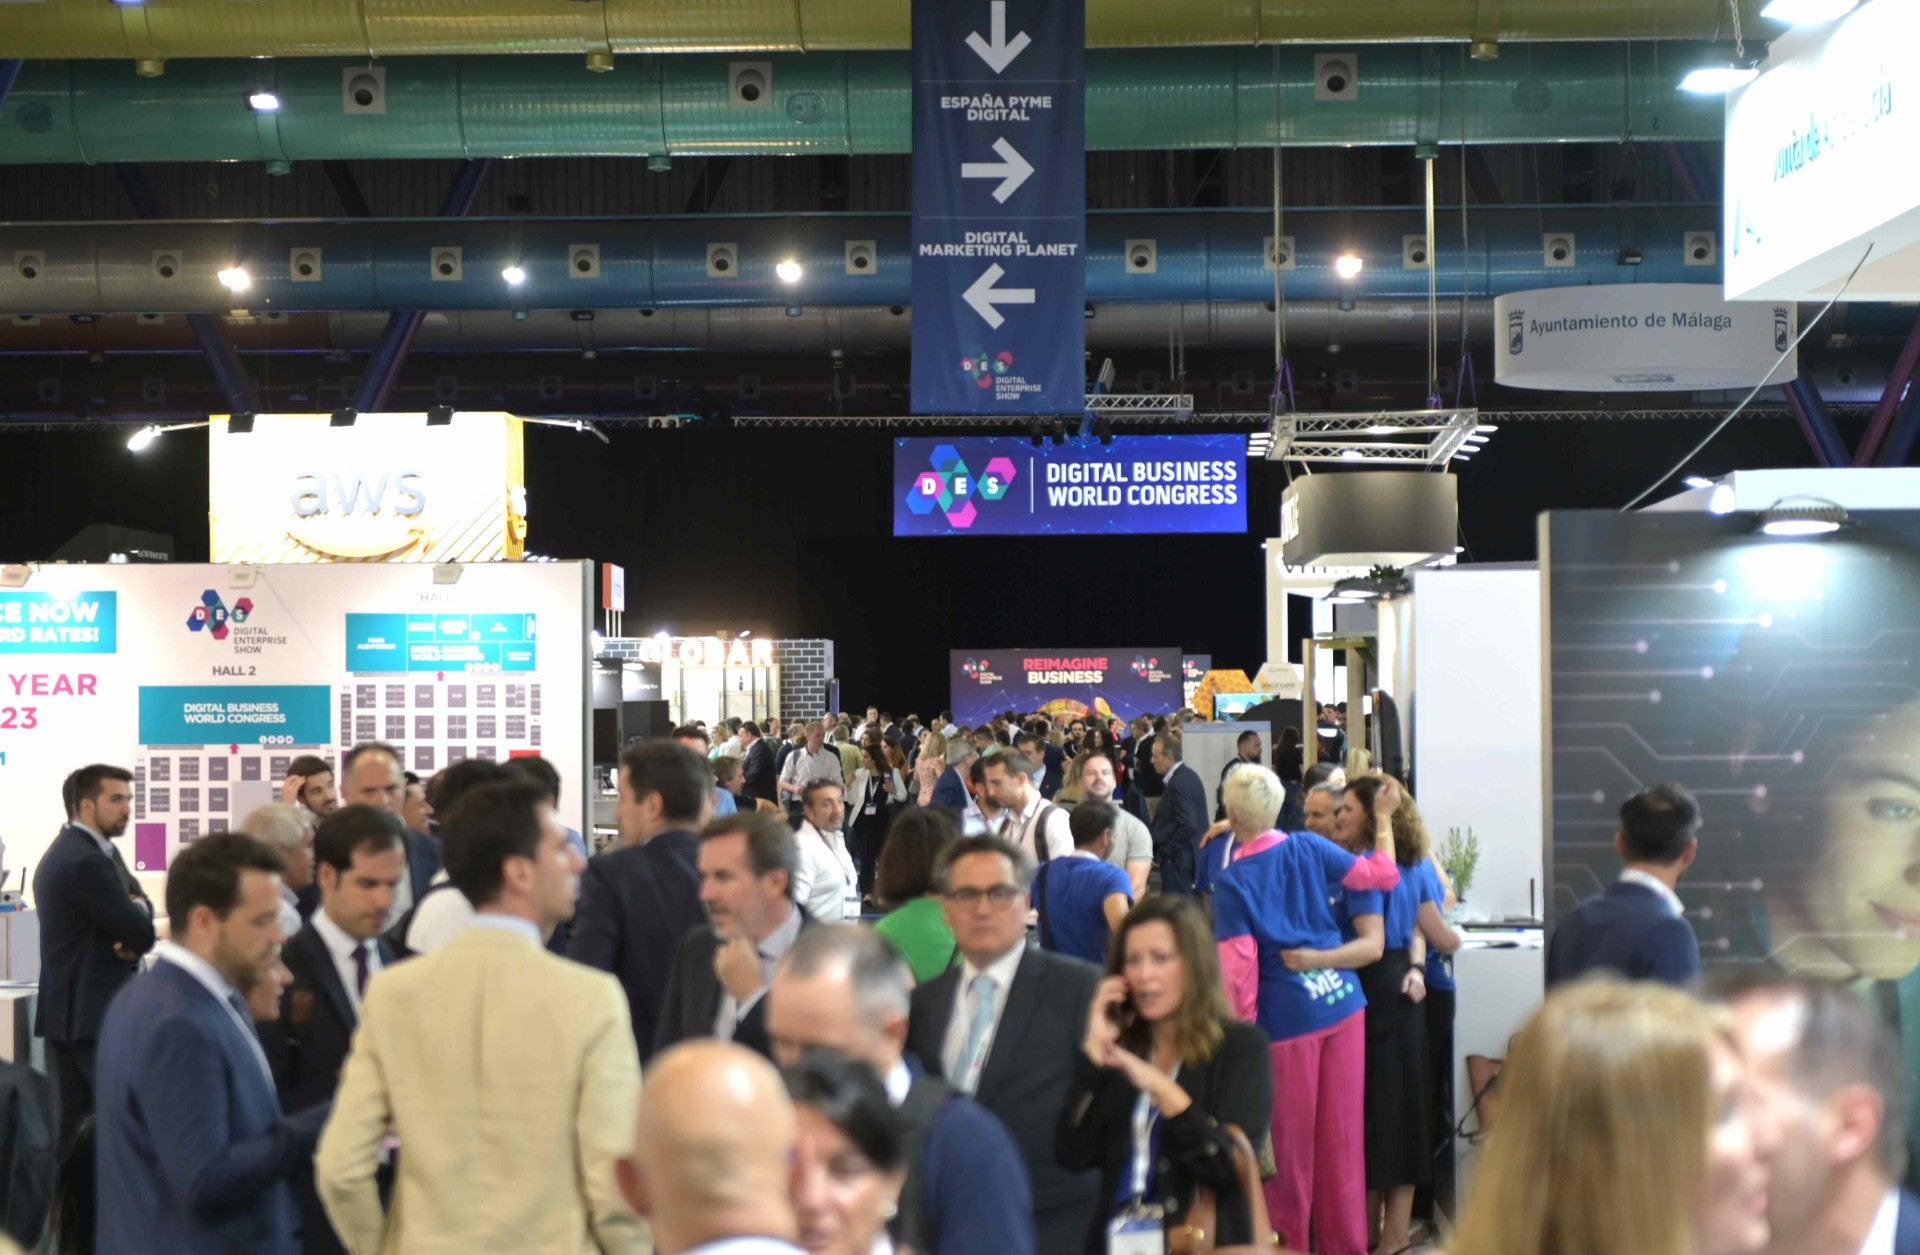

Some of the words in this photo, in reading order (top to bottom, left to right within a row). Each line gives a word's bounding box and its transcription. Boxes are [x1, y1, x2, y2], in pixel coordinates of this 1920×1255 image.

[941, 93, 1005, 109] ESPAÑA
[1009, 96, 1052, 109] PYME
[967, 109, 1030, 121] DIGITAL
[965, 232, 1028, 243] DIGITAL
[920, 244, 1012, 257] MARKETING
[1016, 243, 1078, 256] PLANET
[1530, 312, 1639, 337] Ayuntamiento
[1645, 311, 1666, 329] de
[1672, 311, 1732, 331] Málaga
[996, 384, 1042, 392] ENTERPRISE
[996, 392, 1021, 400] SHOW
[1047, 461, 1128, 484] DIGITAL
[1133, 460, 1237, 482] BUSINESS
[289, 468, 427, 518] aws
[1048, 485, 1122, 507] WORLD
[1128, 484, 1238, 506] CONGRESS
[29, 601, 100, 623] NOW
[30, 626, 100, 643] RATES!
[234, 627, 268, 635] DIGITAL
[234, 636, 288, 645] ENTERPRISE
[234, 645, 262, 654] SHOW
[212, 665, 246, 676] HALL
[248, 665, 256, 676] 2
[1023, 657, 1109, 671] REIMAGINE
[1028, 671, 1104, 684] BUSINESS
[8, 673, 98, 696] YEAR
[184, 703, 225, 713] DIGITAL
[227, 703, 279, 713] BUSINESS
[0, 706, 38, 730] 23
[184, 714, 225, 724] WORLD
[227, 714, 286, 724] CONGRESS
